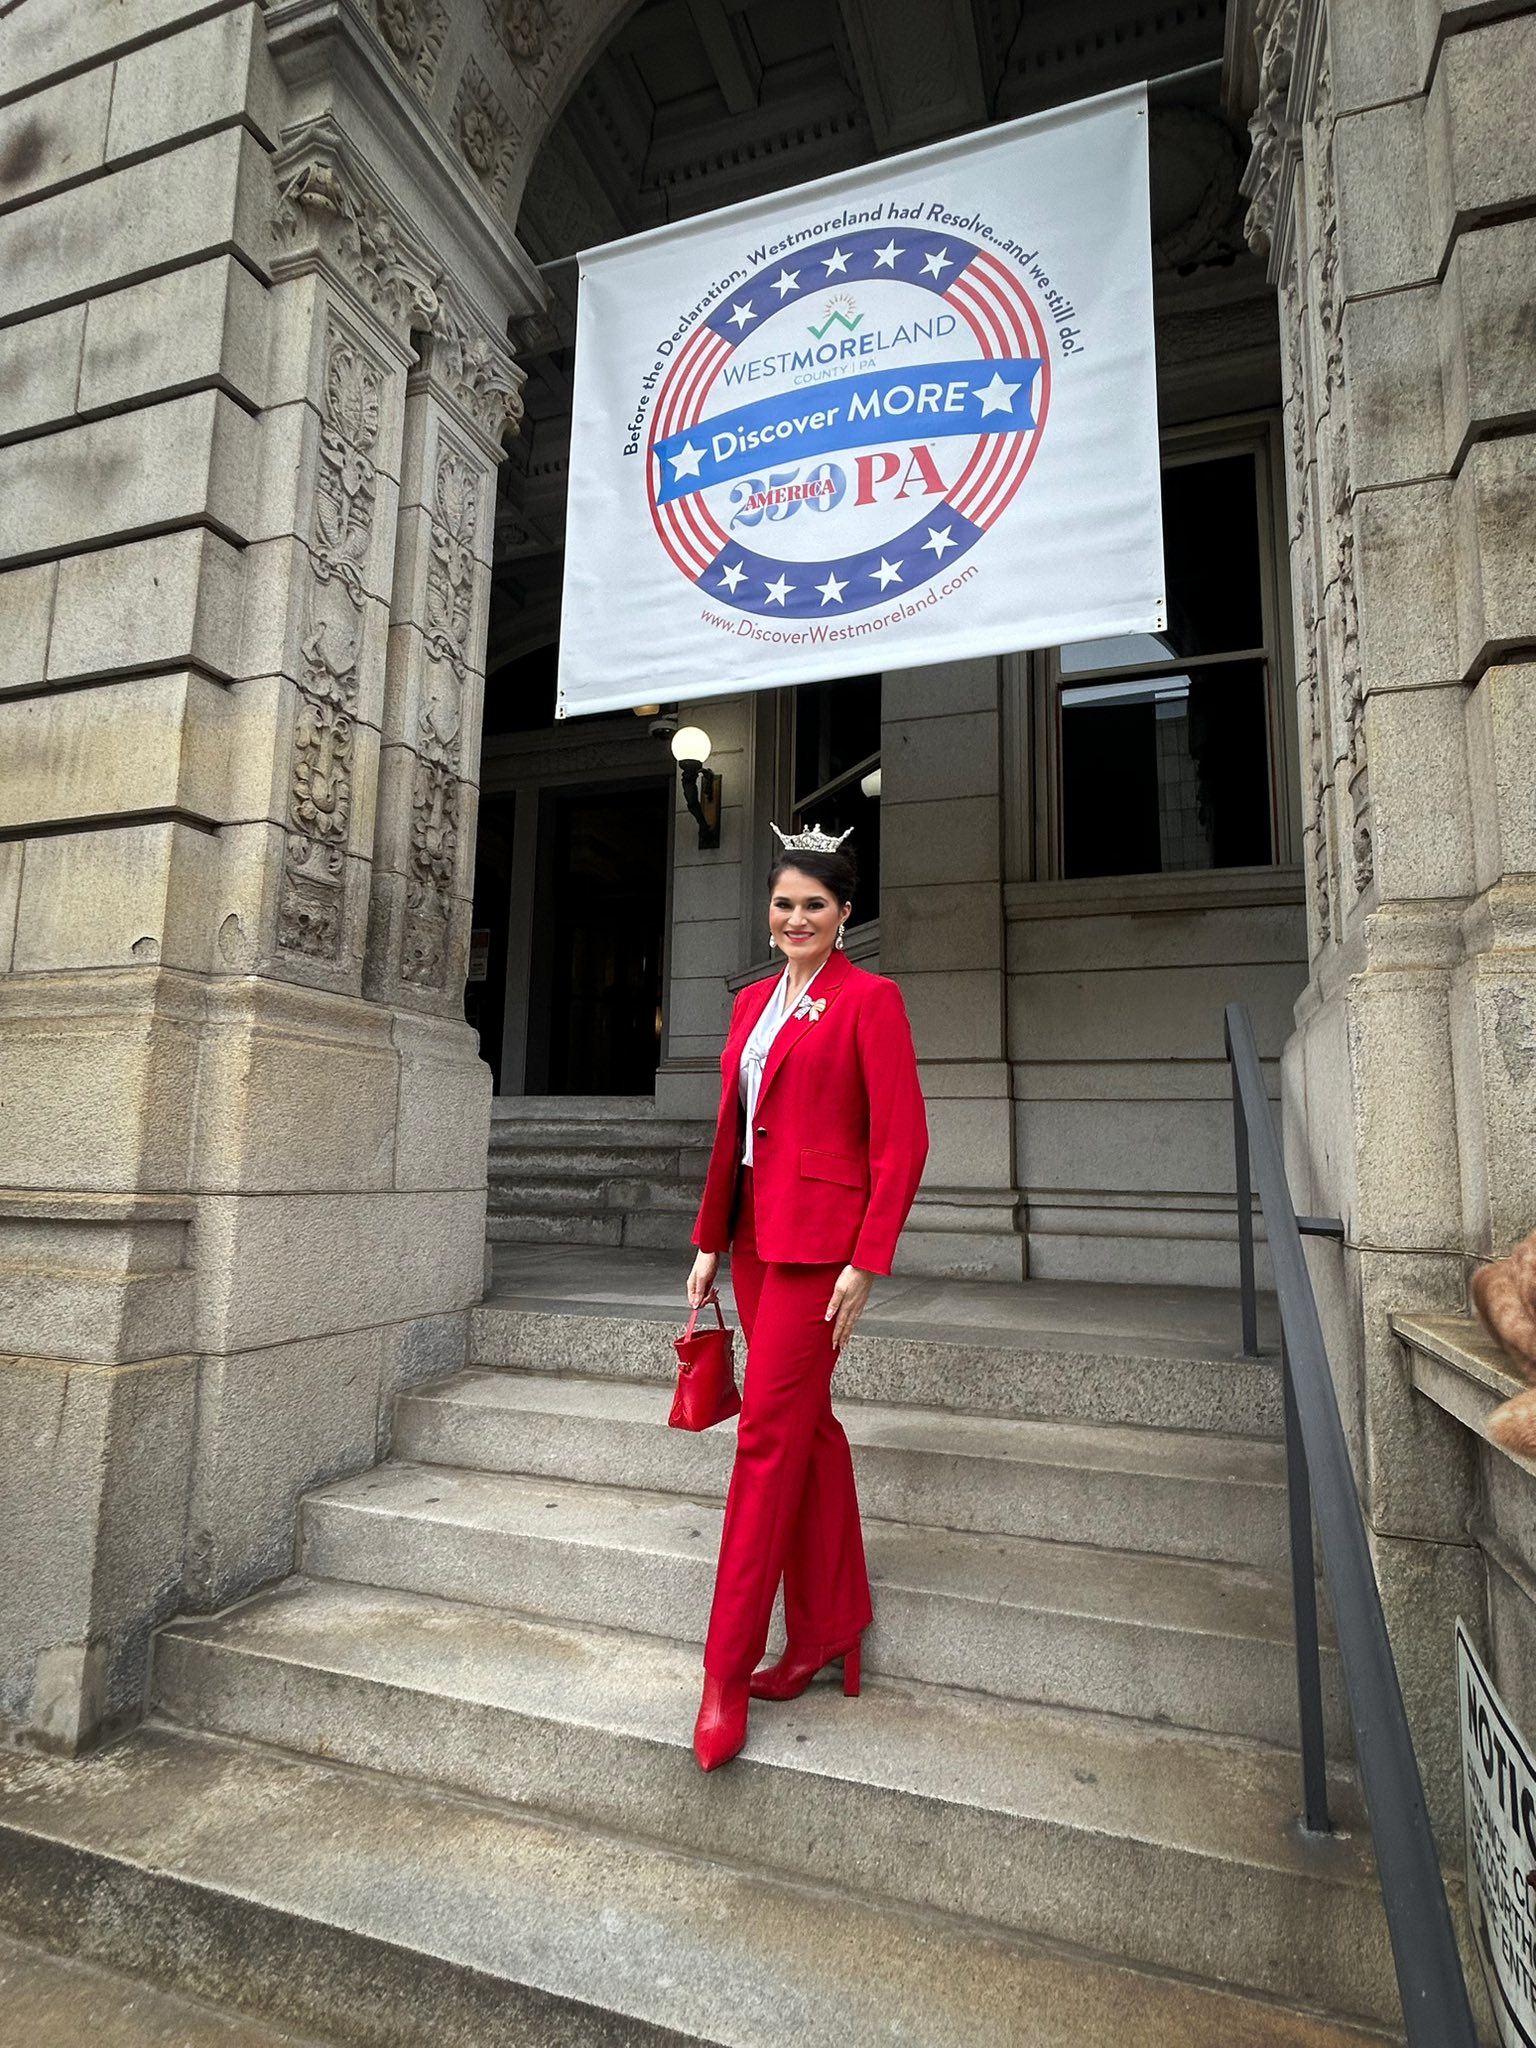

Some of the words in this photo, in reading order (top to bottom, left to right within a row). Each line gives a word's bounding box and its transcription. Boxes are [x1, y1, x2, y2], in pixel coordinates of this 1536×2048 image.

[746, 204, 883, 266] Westmoreland
[887, 202, 924, 220] had
[1029, 264, 1050, 289] we
[1044, 289, 1076, 324] still
[656, 268, 748, 356] Declaration,
[1058, 326, 1085, 358] do!
[643, 362, 664, 391] the
[723, 314, 956, 387] WESTMORELAND
[793, 365, 847, 386] COUNTY
[859, 358, 876, 370] PA
[623, 395, 650, 456] Before
[711, 407, 840, 463] Discover
[847, 381, 969, 422] MORE
[729, 463, 847, 531] 250
[854, 445, 949, 507] PA
[744, 478, 836, 511] AMERICA
[700, 564, 979, 644] www.DiscoverWestmoreland.com
[1485, 1841, 1536, 1973] COURTH
